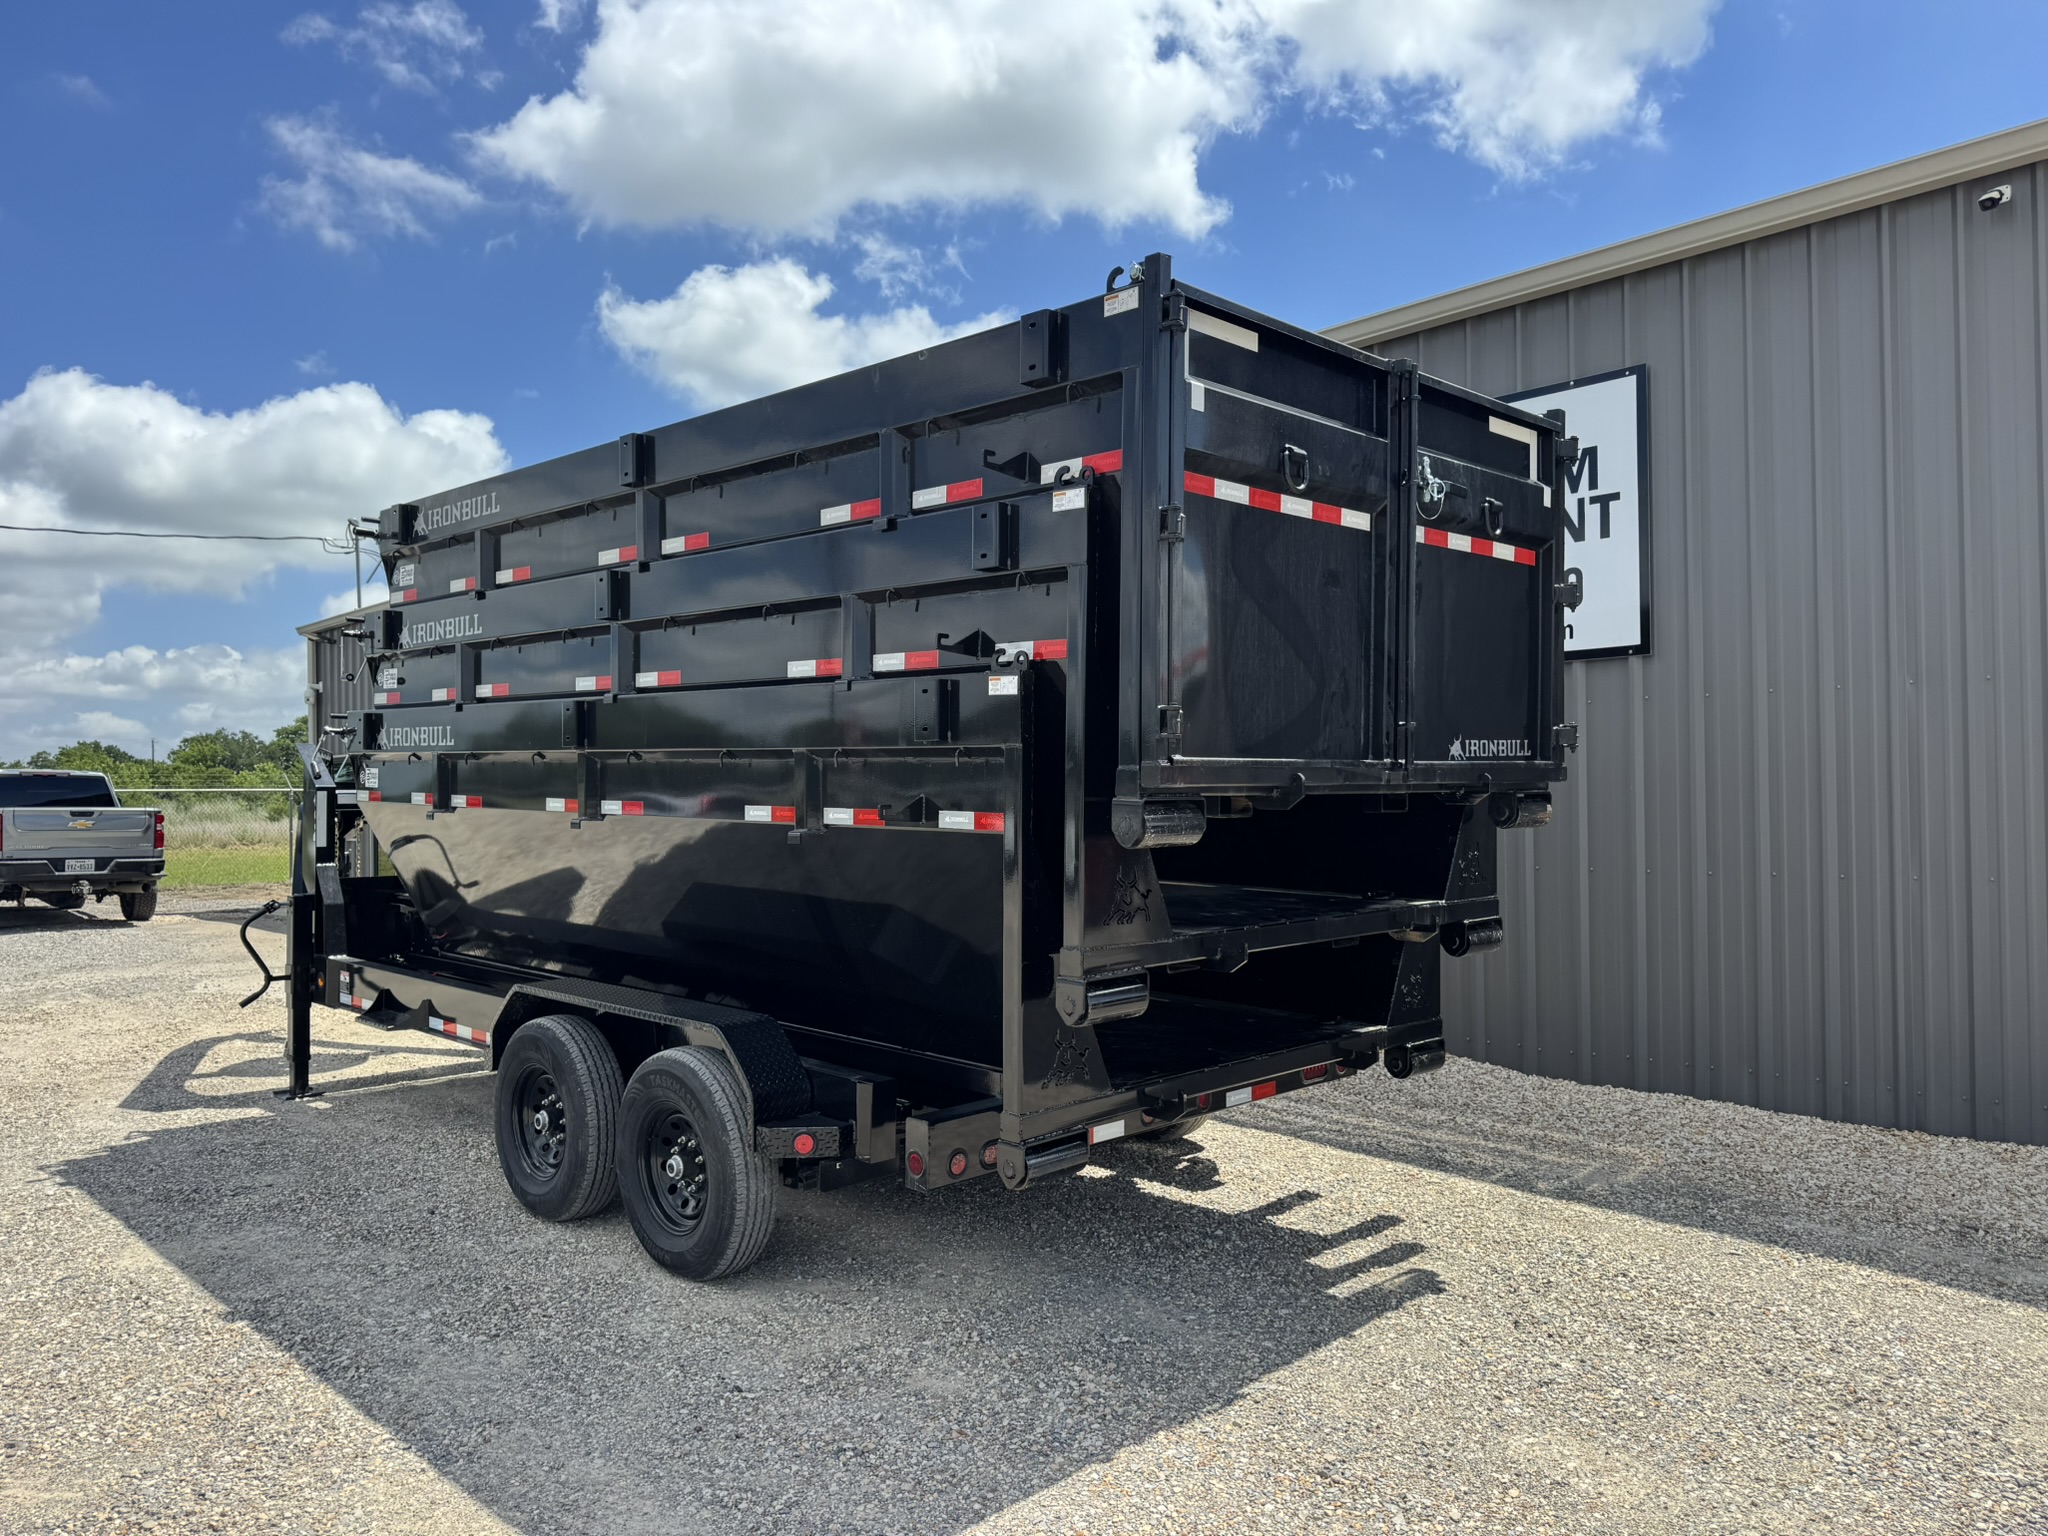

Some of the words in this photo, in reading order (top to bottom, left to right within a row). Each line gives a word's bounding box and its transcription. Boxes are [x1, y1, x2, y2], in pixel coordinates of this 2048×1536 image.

[428, 492, 500, 530] IRONBULL
[412, 614, 483, 644] IRONBULL
[389, 726, 455, 747] IRONBULL
[1465, 739, 1531, 757] IRONBULL
[649, 1074, 705, 1128] TASKMASTER
